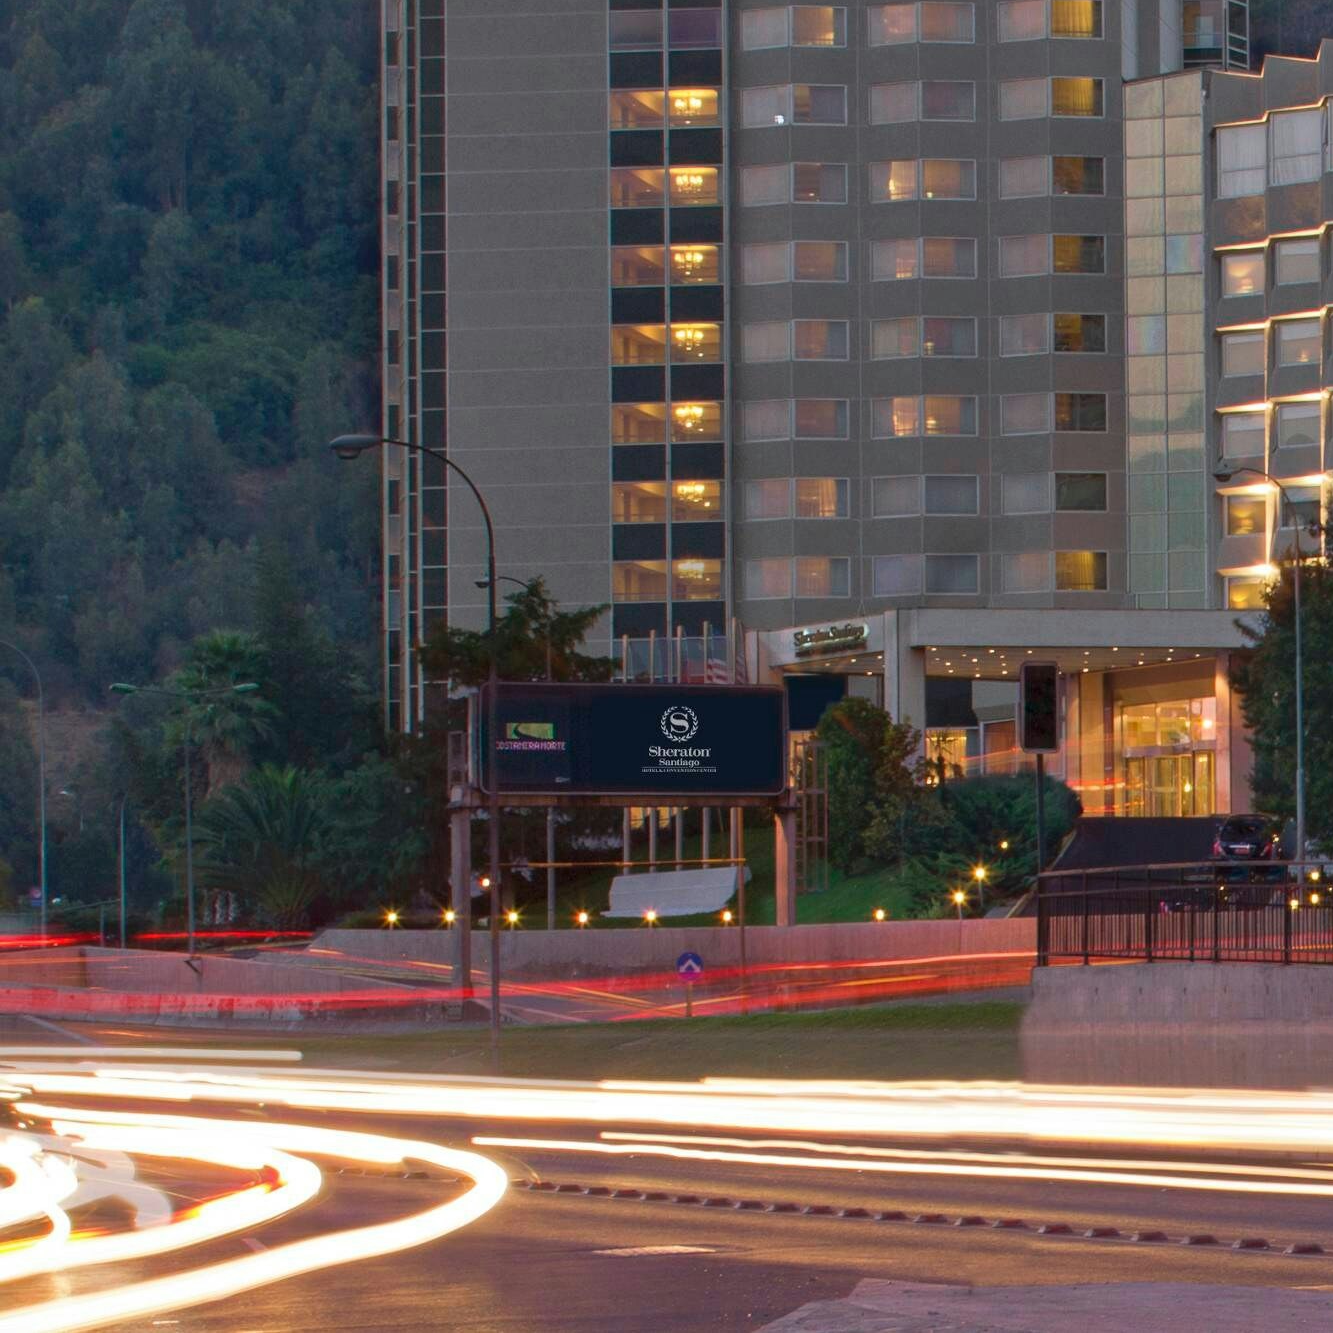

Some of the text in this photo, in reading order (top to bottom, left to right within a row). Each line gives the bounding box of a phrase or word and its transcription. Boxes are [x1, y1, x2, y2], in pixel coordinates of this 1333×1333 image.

[669, 712, 690, 734] S
[648, 746, 711, 757] Sheraton
[658, 757, 700, 768] Santiago
